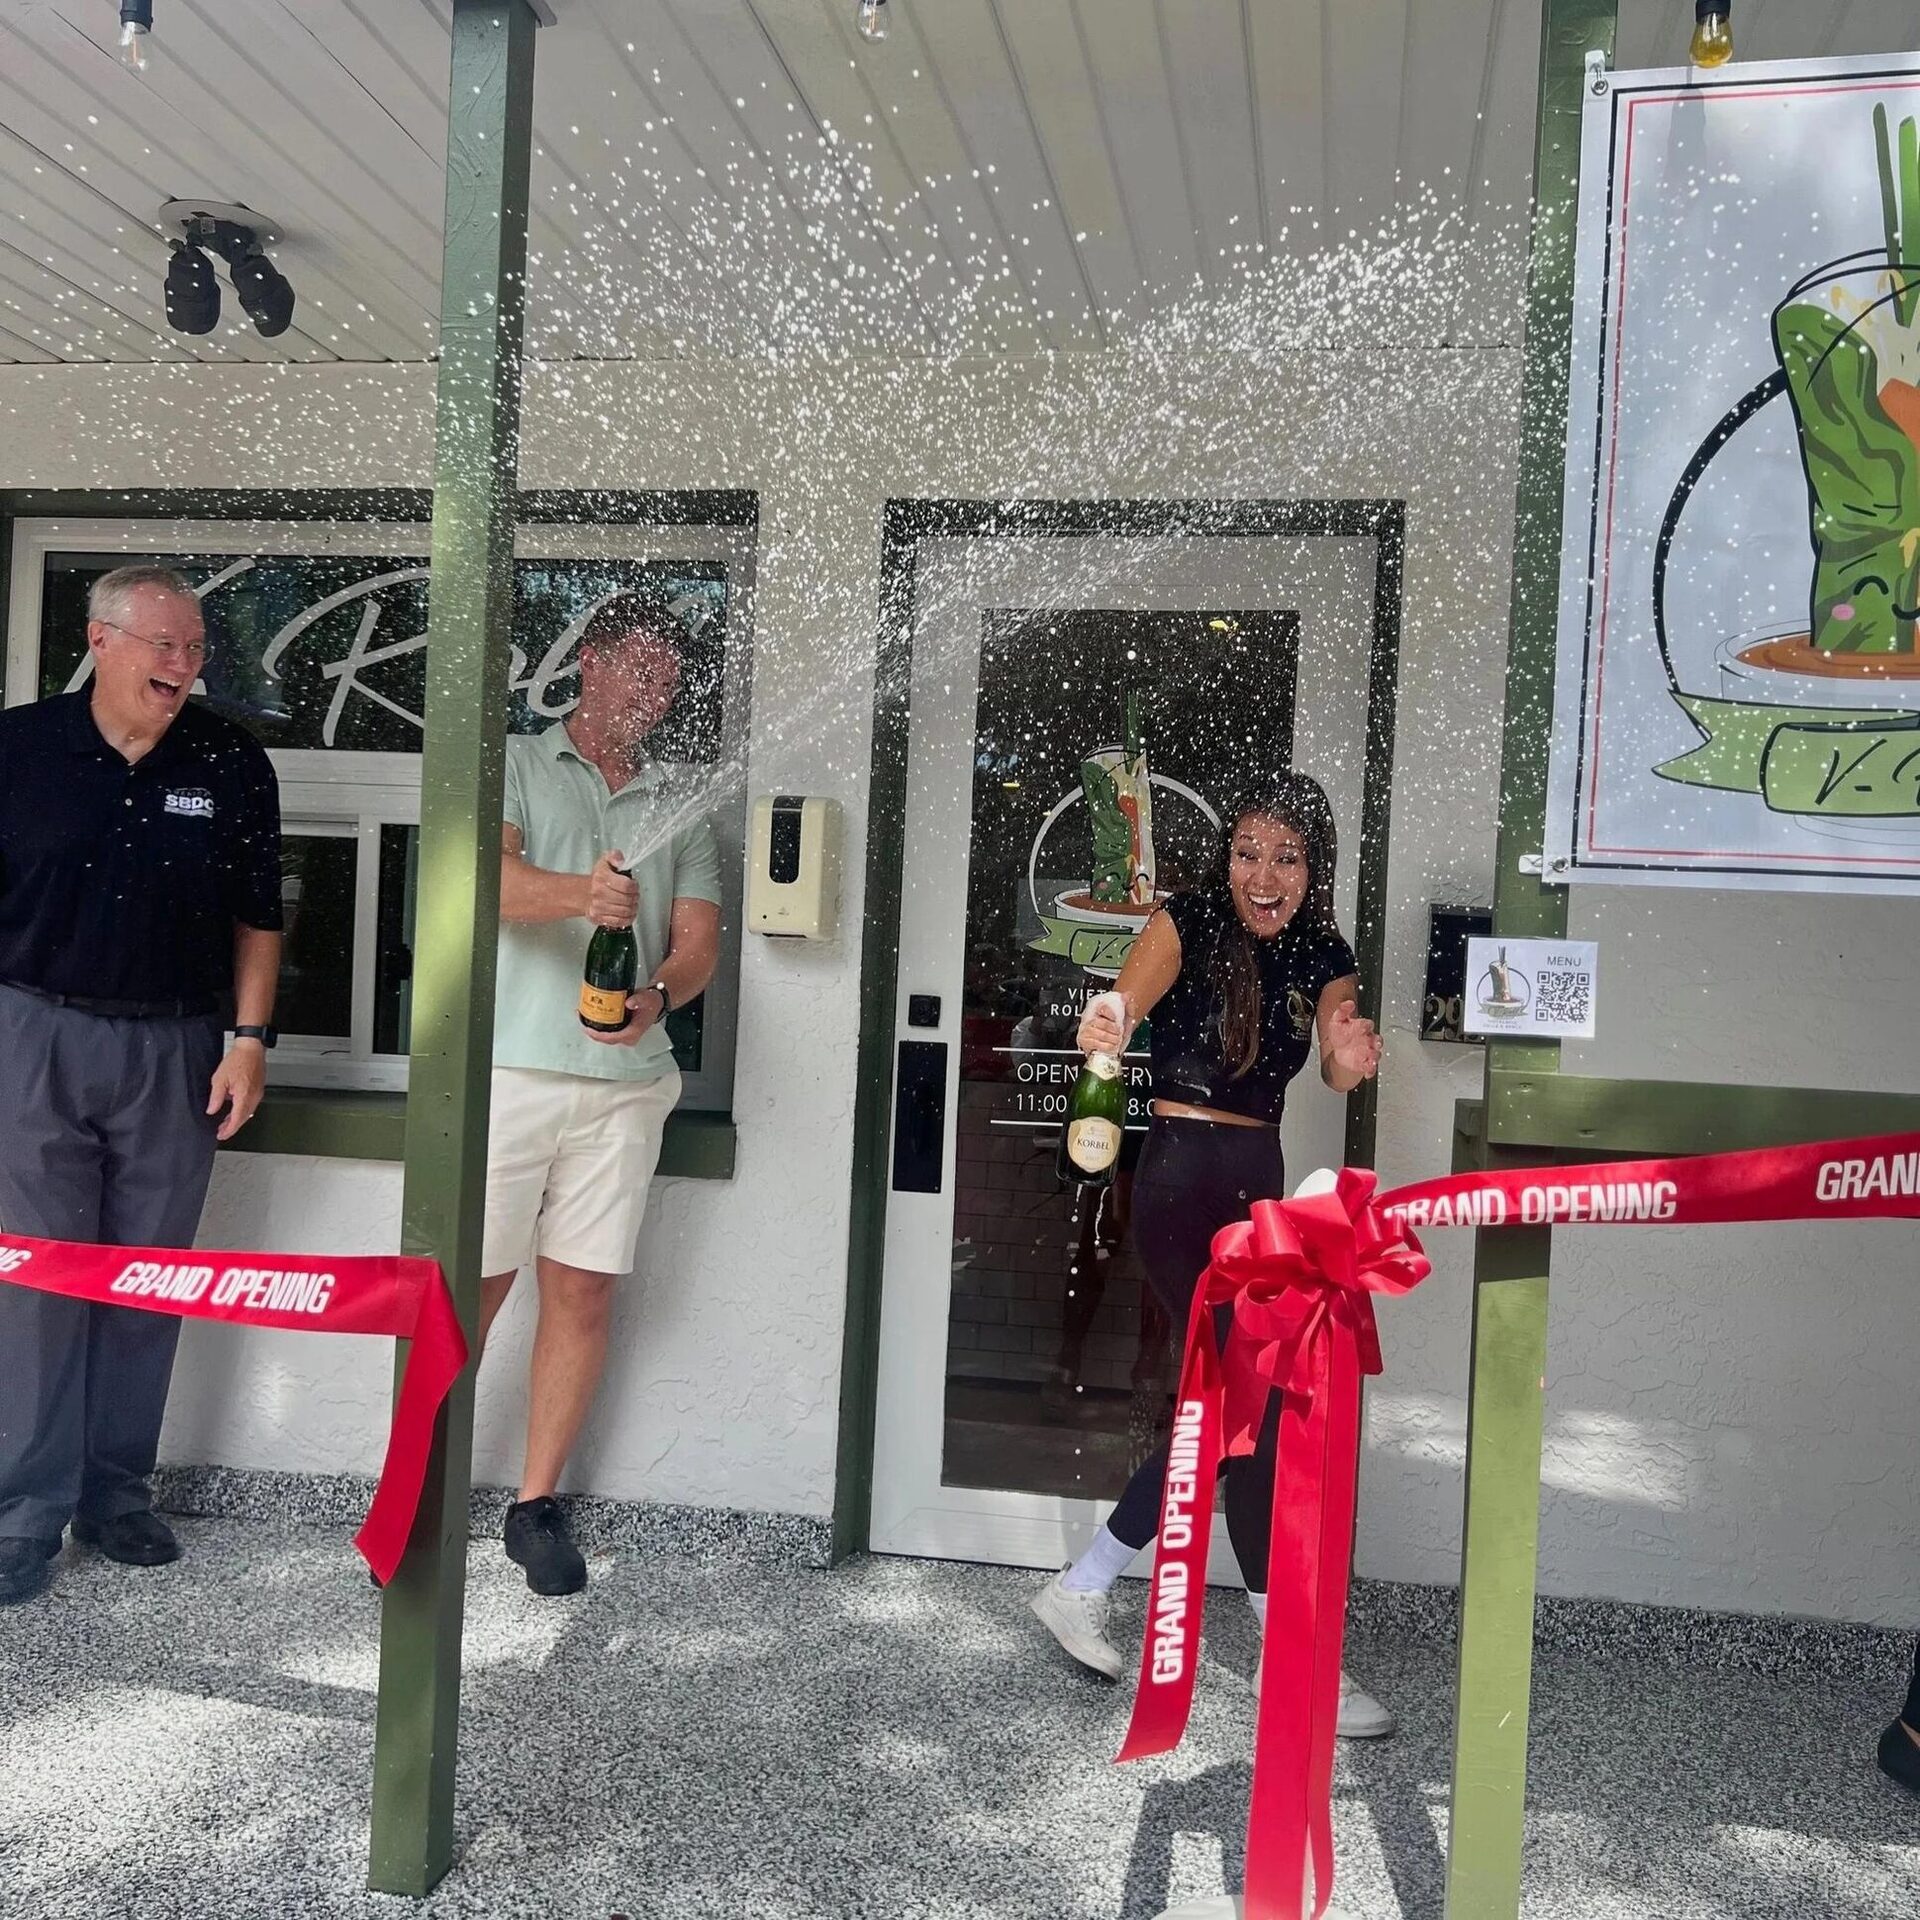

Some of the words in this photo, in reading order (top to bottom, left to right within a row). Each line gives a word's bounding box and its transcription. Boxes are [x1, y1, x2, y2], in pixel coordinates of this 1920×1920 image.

[1814, 738, 1920, 807] V-
[164, 794, 215, 811] SBDC
[1091, 937, 1136, 963] V-
[1546, 956, 1582, 967] MENU
[1068, 988, 1107, 1001] VIET
[1050, 1003, 1081, 1017] ROL
[1422, 995, 1483, 1042] 29
[1017, 1062, 1079, 1083] OPEN
[1016, 1093, 1067, 1113] 11:00
[1127, 1097, 1155, 1117] 8:0
[1076, 1137, 1109, 1150] KORBEL
[1815, 1152, 1920, 1201] GRAN
[1521, 1181, 1678, 1223] OPENING
[111, 1261, 214, 1302] GRAND
[210, 1267, 335, 1314] OPENING
[1162, 1399, 1204, 1550] OPENING
[1152, 1561, 1189, 1685] GRAND
